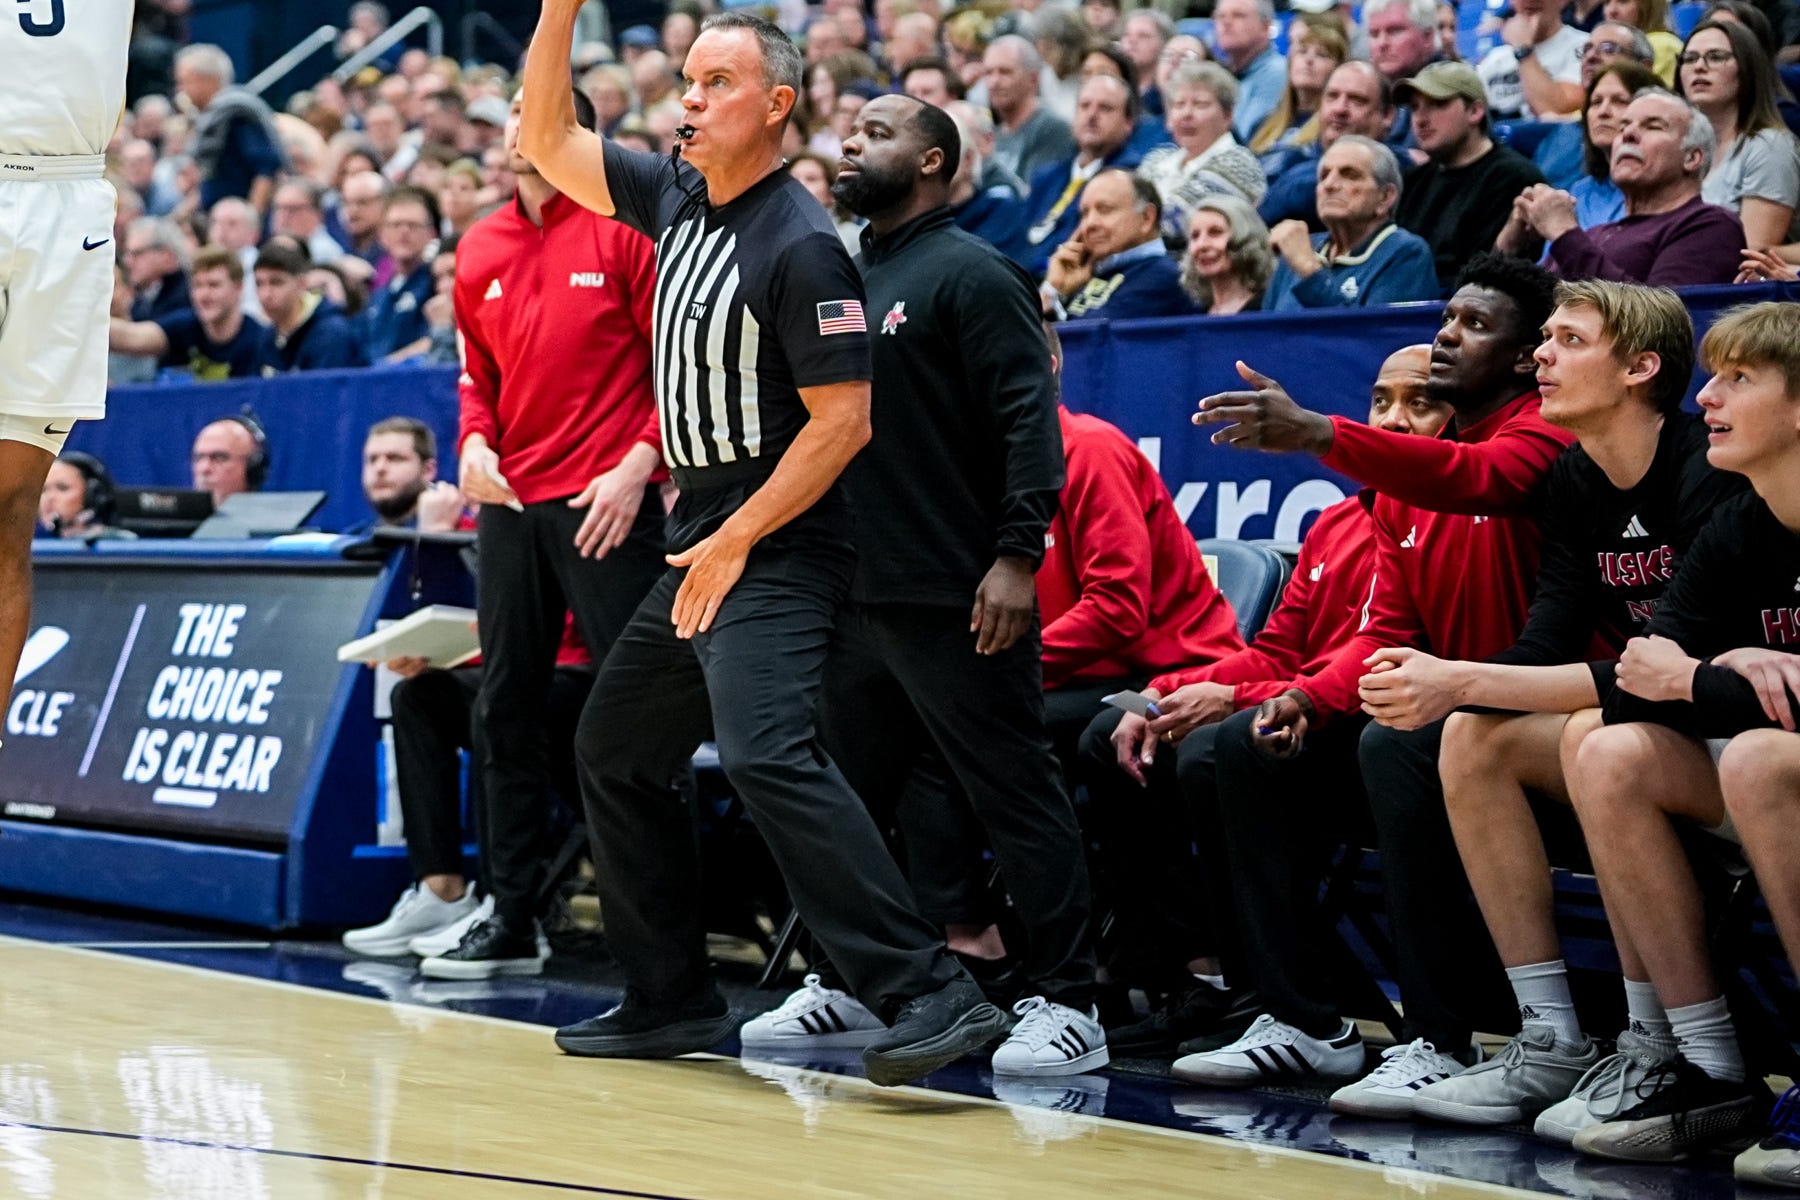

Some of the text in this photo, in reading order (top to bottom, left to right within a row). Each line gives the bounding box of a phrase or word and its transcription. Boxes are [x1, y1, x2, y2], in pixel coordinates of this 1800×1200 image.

[3, 163, 34, 171] AKRON
[569, 272, 605, 287] NIU
[690, 302, 707, 320] TW
[171, 603, 247, 659] THE
[6, 689, 75, 737] CLE
[147, 665, 283, 725] CHOICE
[122, 727, 283, 793] IS CLEAR
